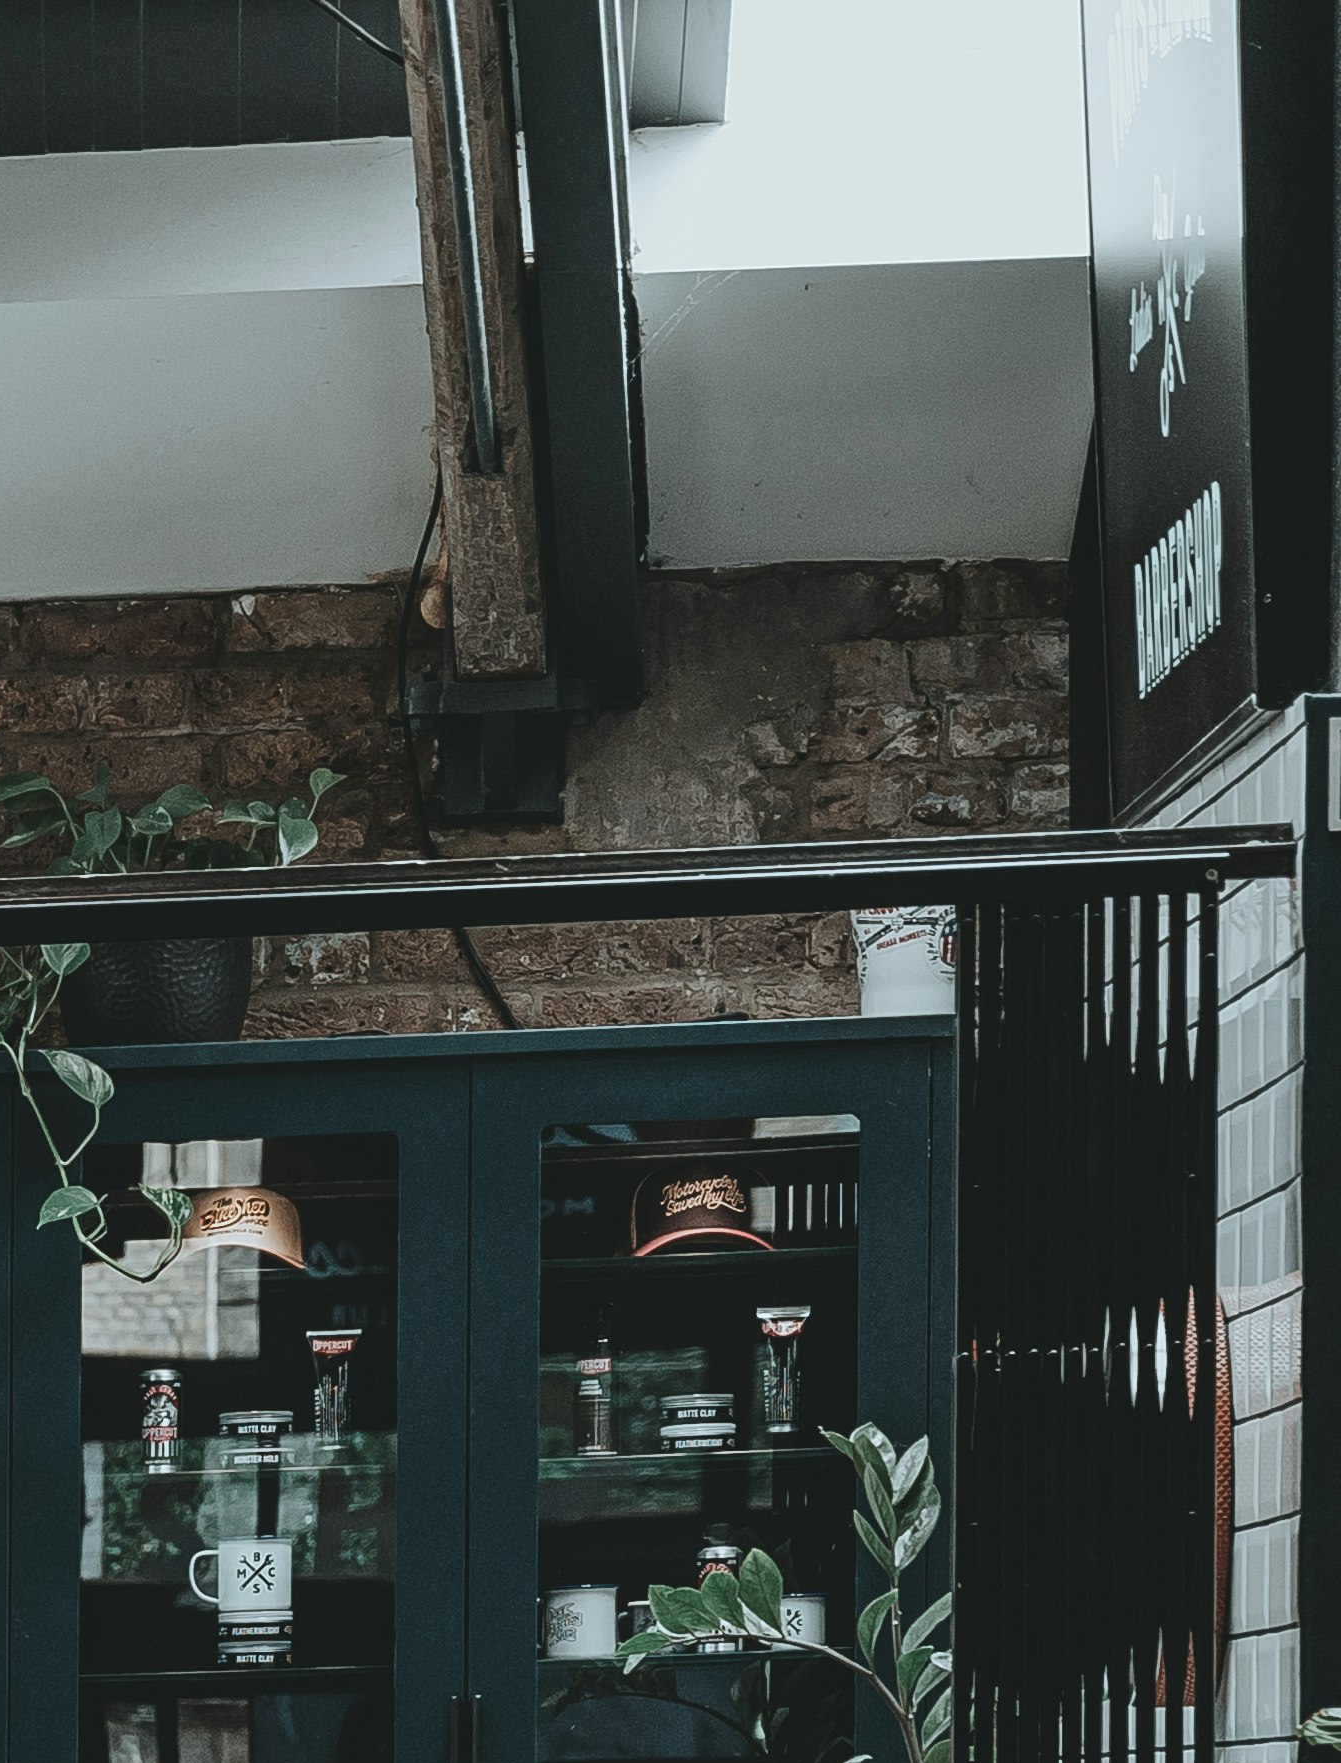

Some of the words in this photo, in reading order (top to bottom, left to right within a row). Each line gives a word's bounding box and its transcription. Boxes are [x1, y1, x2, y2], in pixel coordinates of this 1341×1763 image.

[1134, 480, 1221, 699] BARBERSHOP
[665, 1193, 703, 1216] Saved
[312, 1339, 354, 1351] UPPERCUT
[700, 1408, 717, 1417] CLAY
[260, 1424, 277, 1433] CLAY
[253, 1552, 261, 1563] B
[237, 1568, 246, 1579] M
[267, 1567, 276, 1578] C
[253, 1583, 261, 1594] S
[258, 1654, 274, 1663] CLAY
